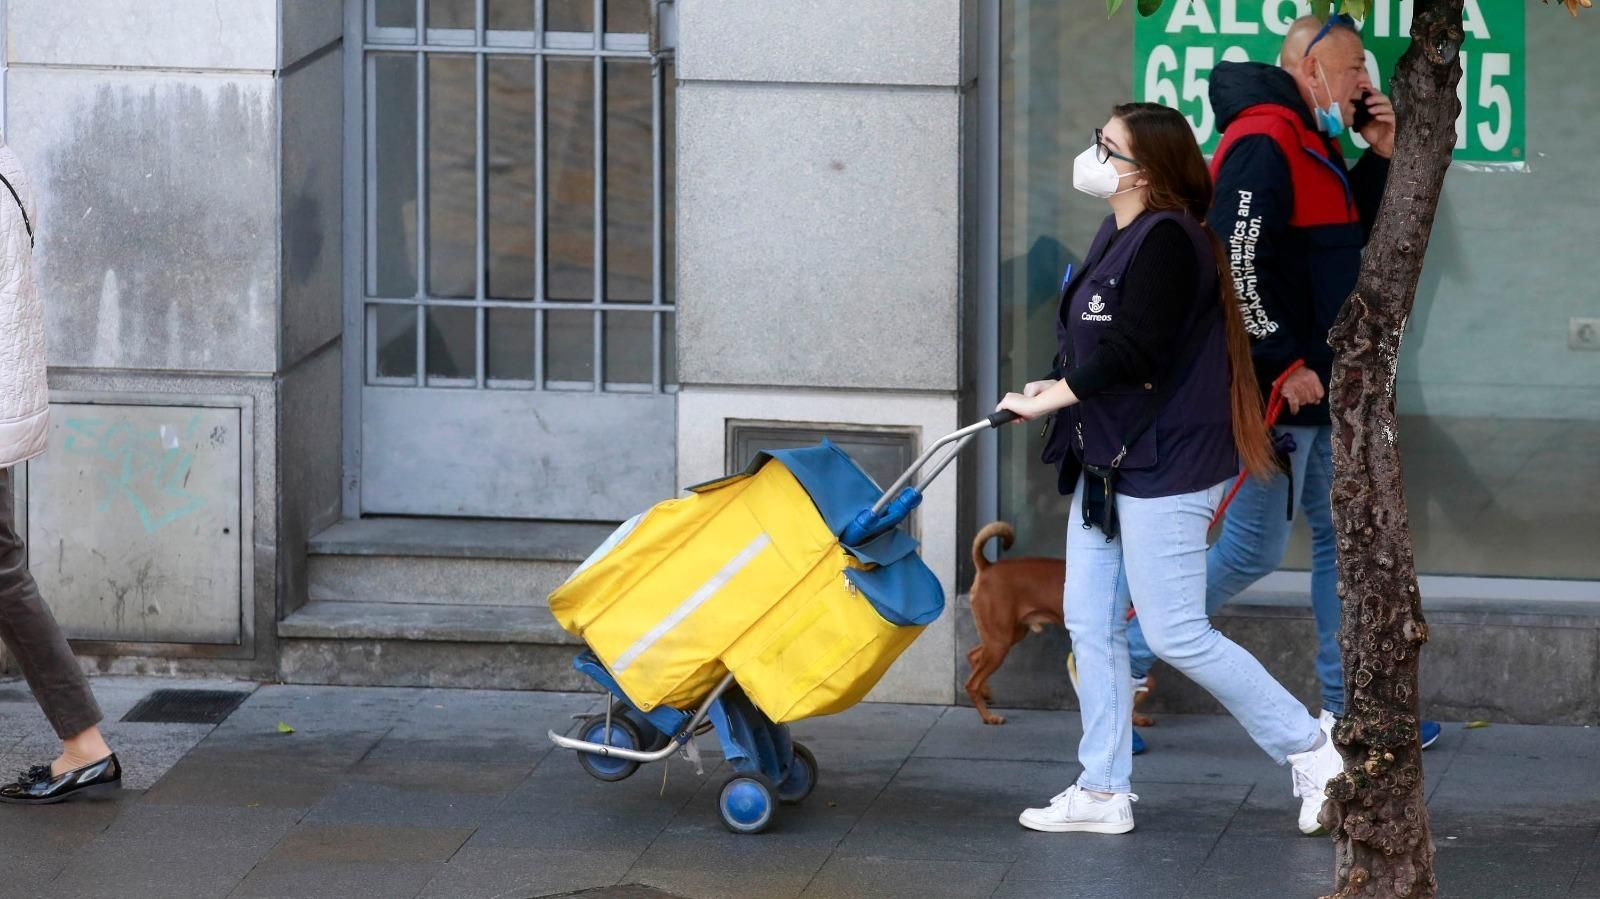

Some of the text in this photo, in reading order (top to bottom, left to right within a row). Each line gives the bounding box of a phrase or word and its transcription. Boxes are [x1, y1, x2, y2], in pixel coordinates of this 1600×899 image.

[1165, 0, 1491, 40] ALQI
[1238, 190, 1252, 217] and
[1081, 312, 1113, 321] Correos
